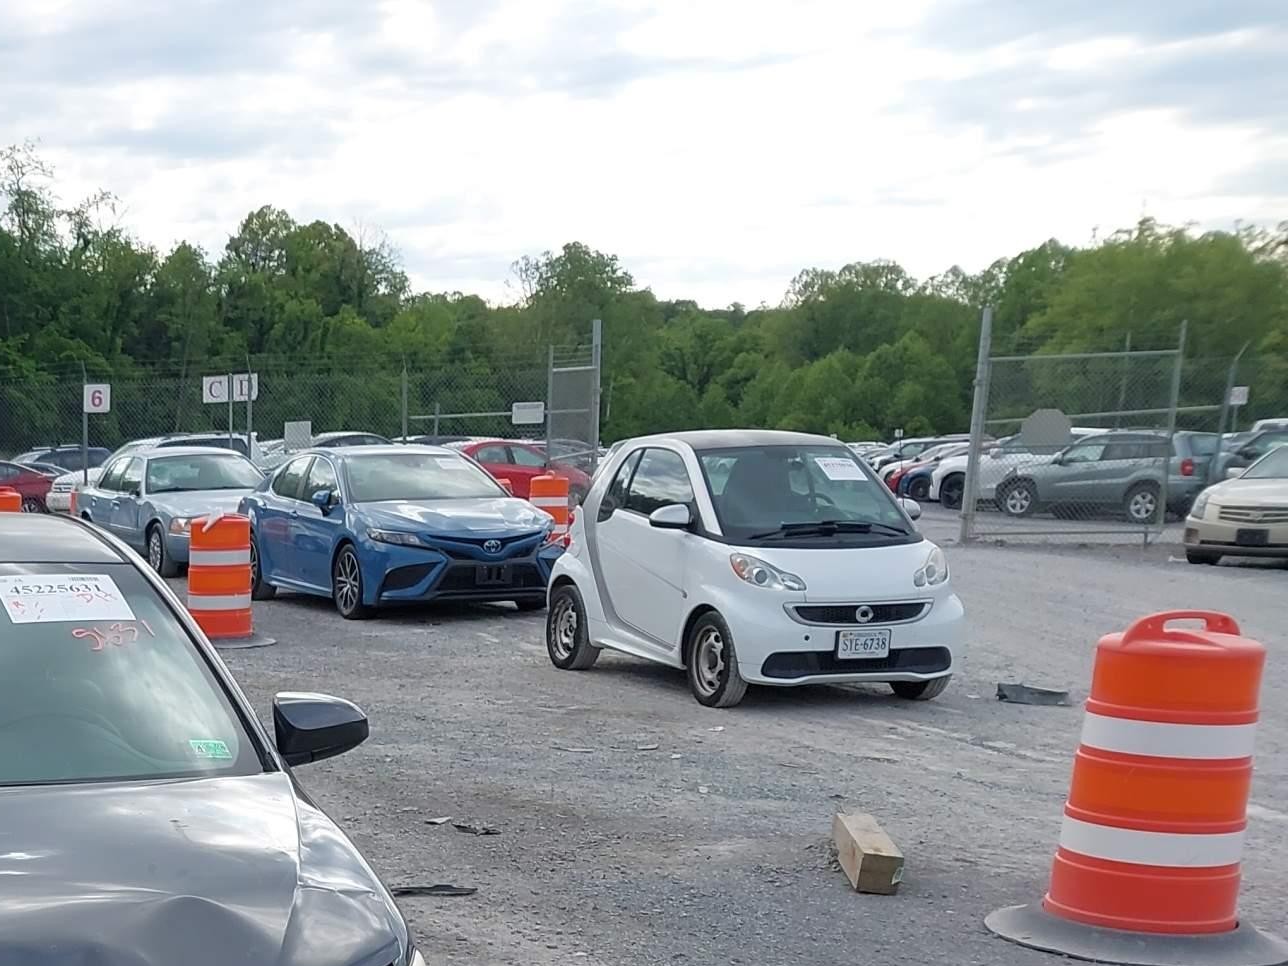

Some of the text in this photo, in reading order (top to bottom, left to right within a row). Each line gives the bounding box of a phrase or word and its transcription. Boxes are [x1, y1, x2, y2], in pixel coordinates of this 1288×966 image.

[91, 389, 103, 408] 6
[208, 380, 223, 399] C
[9, 584, 102, 596] 45225631
